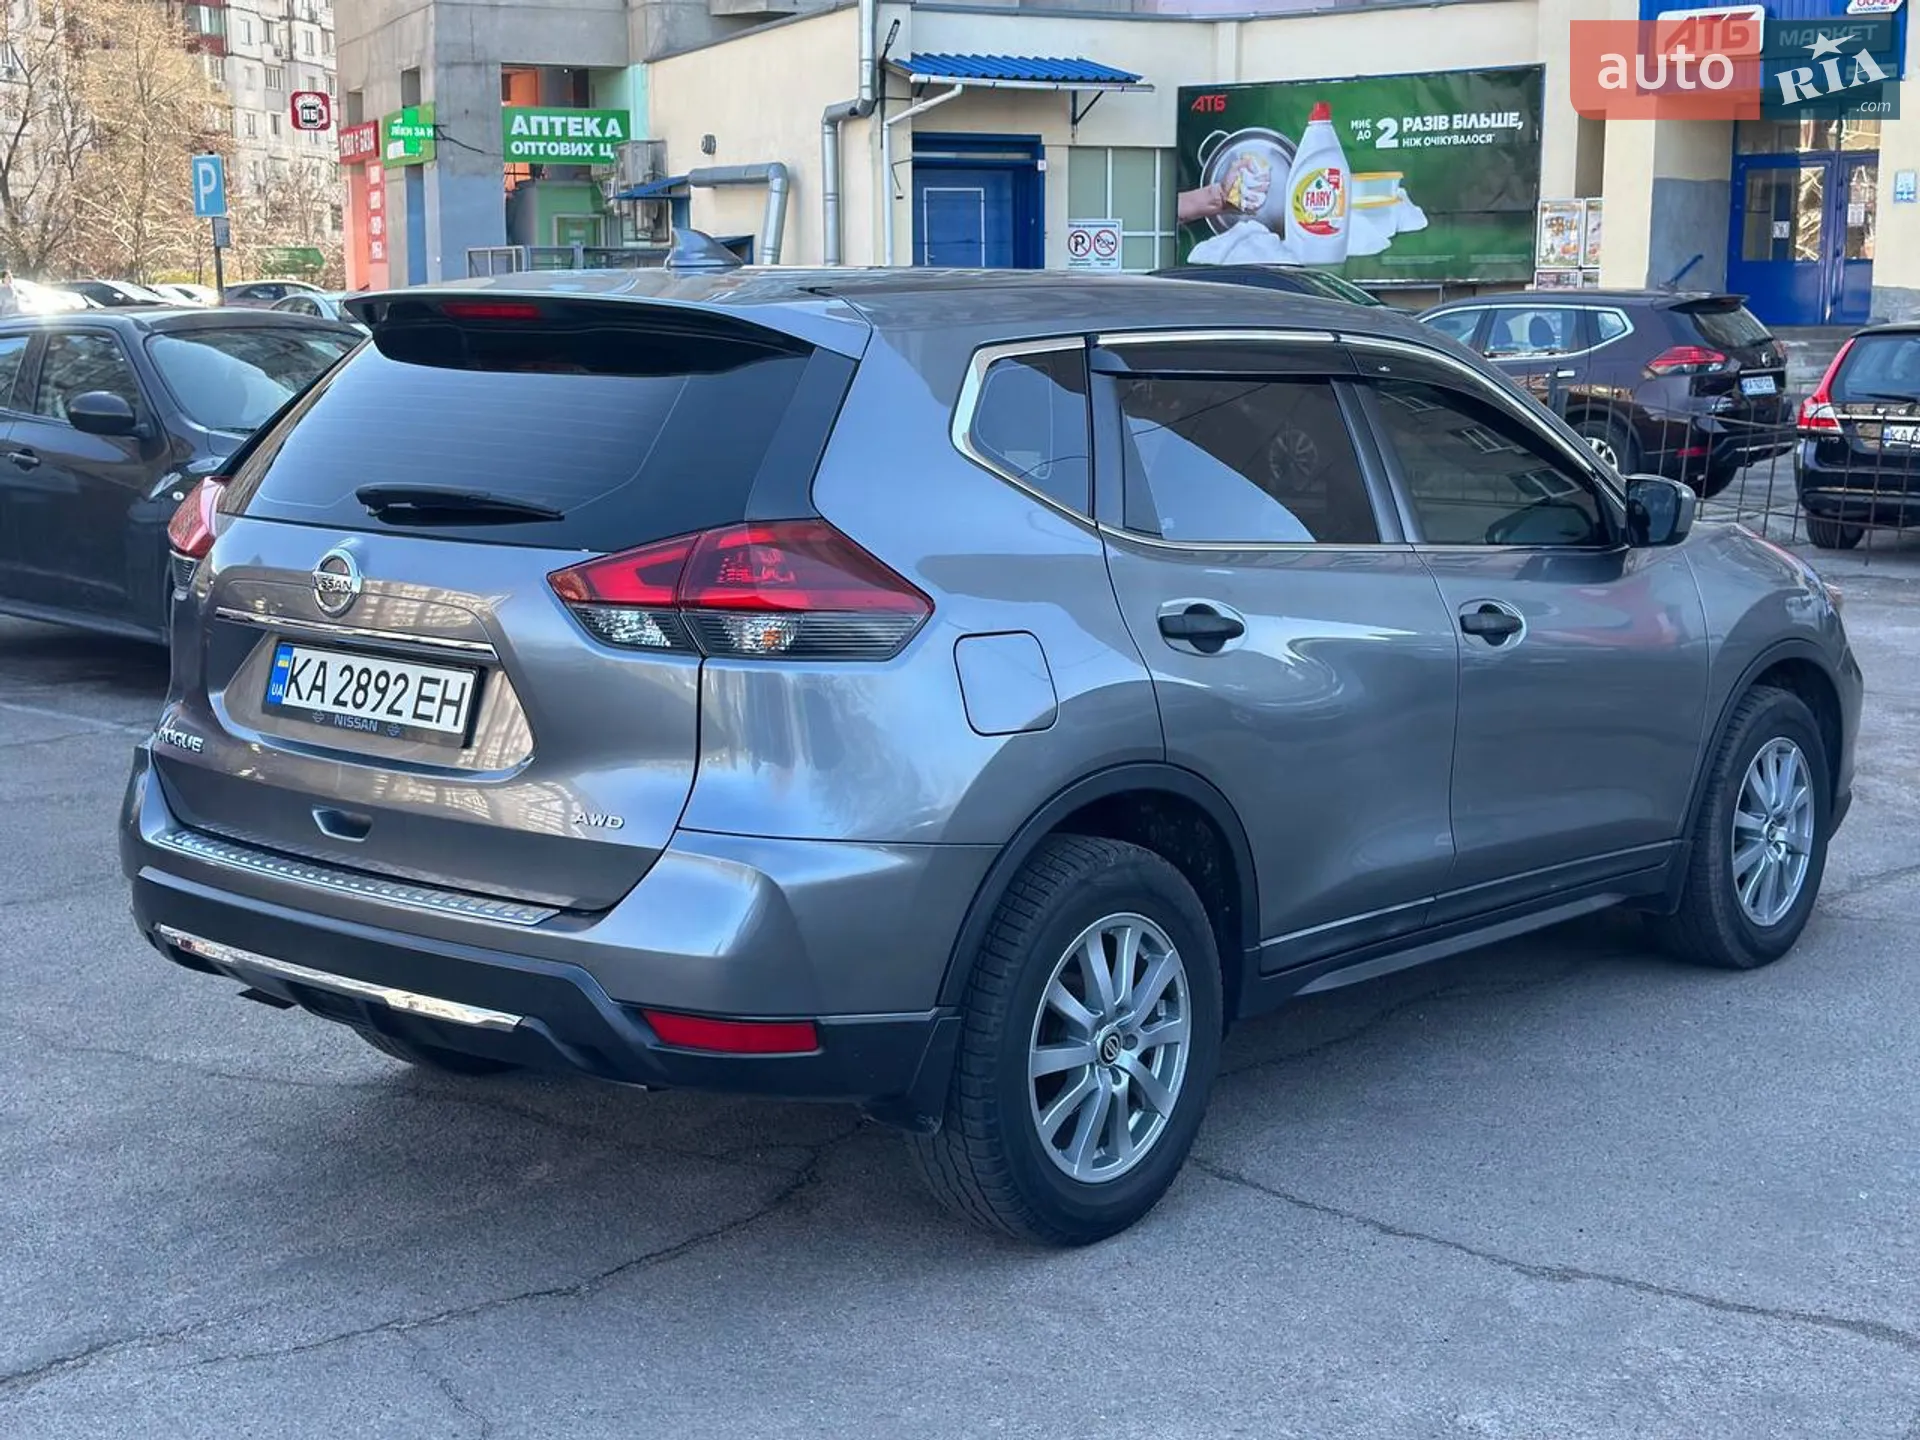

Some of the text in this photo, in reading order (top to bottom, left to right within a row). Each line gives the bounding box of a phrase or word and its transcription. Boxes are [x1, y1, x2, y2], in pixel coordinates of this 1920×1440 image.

[1191, 95, 1227, 112] АТБ
[510, 114, 623, 138] АПТЕКА
[1375, 111, 1524, 149] 2 РАЗІВ БІЛЬШЕ,
[1356, 130, 1371, 141] ДО
[1402, 137, 1422, 148] НІЖ
[510, 140, 594, 157] ОПТОВИХ
[198, 162, 217, 211] P
[271, 683, 284, 697] UA
[285, 656, 467, 727] KA 2892 EH
[334, 714, 378, 732] NISSAN
[572, 811, 625, 831] AWD
